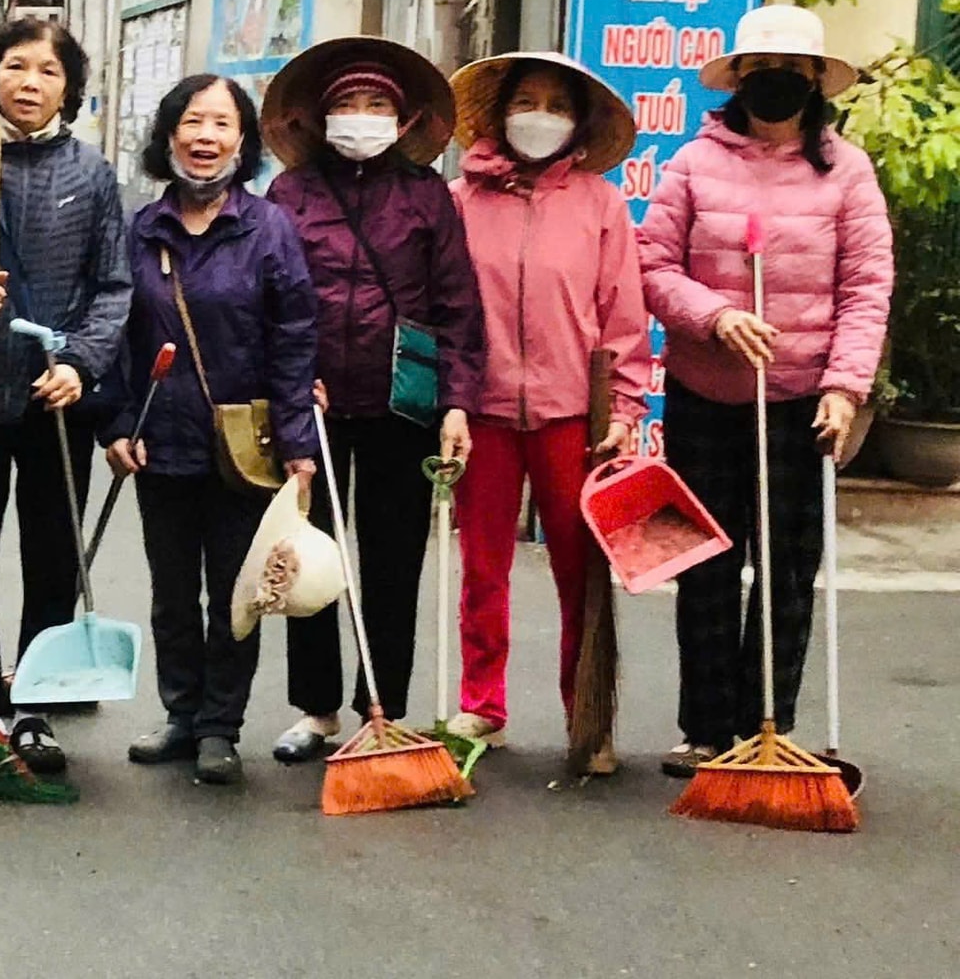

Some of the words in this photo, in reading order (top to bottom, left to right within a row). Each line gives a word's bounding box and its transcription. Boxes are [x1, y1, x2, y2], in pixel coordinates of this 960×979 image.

[603, 17, 675, 68] NGƯỜI
[678, 27, 725, 69] CAO
[634, 78, 687, 135] TUỔI
[622, 145, 659, 200] SỐ
